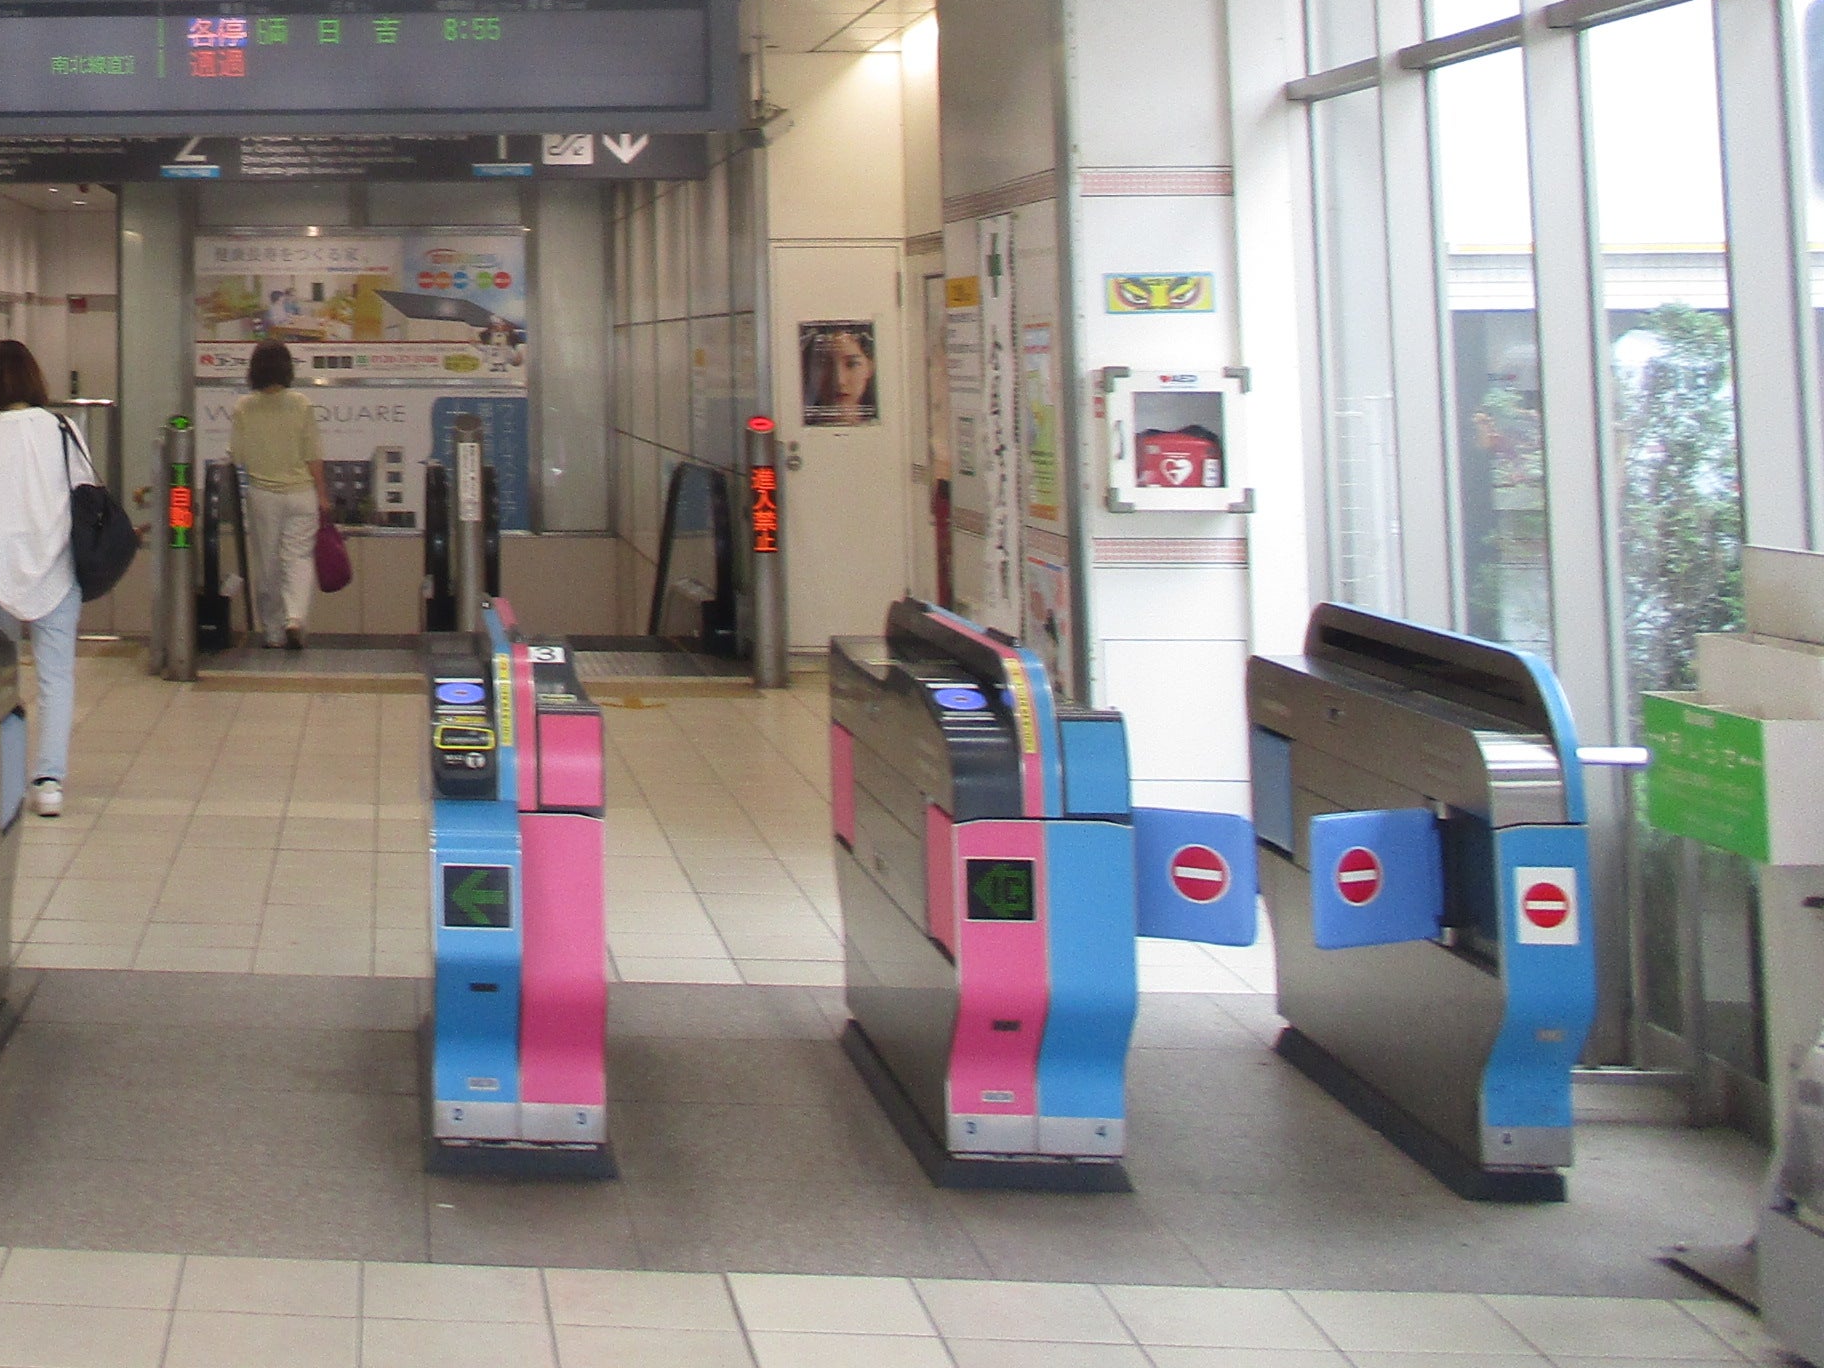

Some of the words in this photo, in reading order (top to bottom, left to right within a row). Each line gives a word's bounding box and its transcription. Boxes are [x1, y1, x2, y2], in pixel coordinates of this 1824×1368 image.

[187, 18, 248, 47] 各停
[751, 466, 778, 553] 進入禁止
